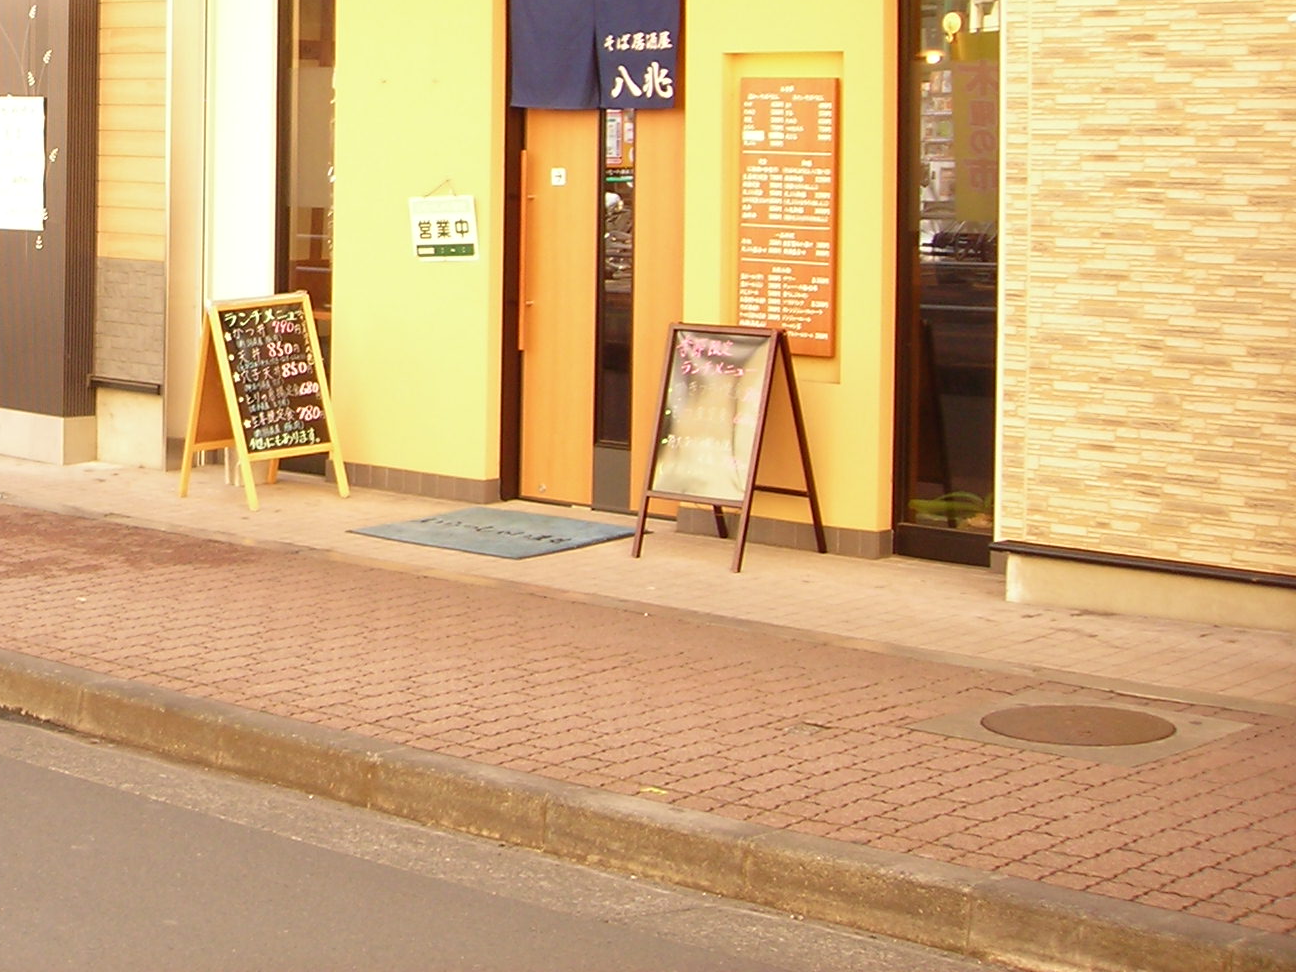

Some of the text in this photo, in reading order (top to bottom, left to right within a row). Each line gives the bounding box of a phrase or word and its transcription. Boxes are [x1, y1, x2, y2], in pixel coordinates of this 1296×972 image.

[604, 30, 673, 52] そば居酒屋
[610, 61, 674, 99] 八兆
[417, 219, 470, 239] 営業中
